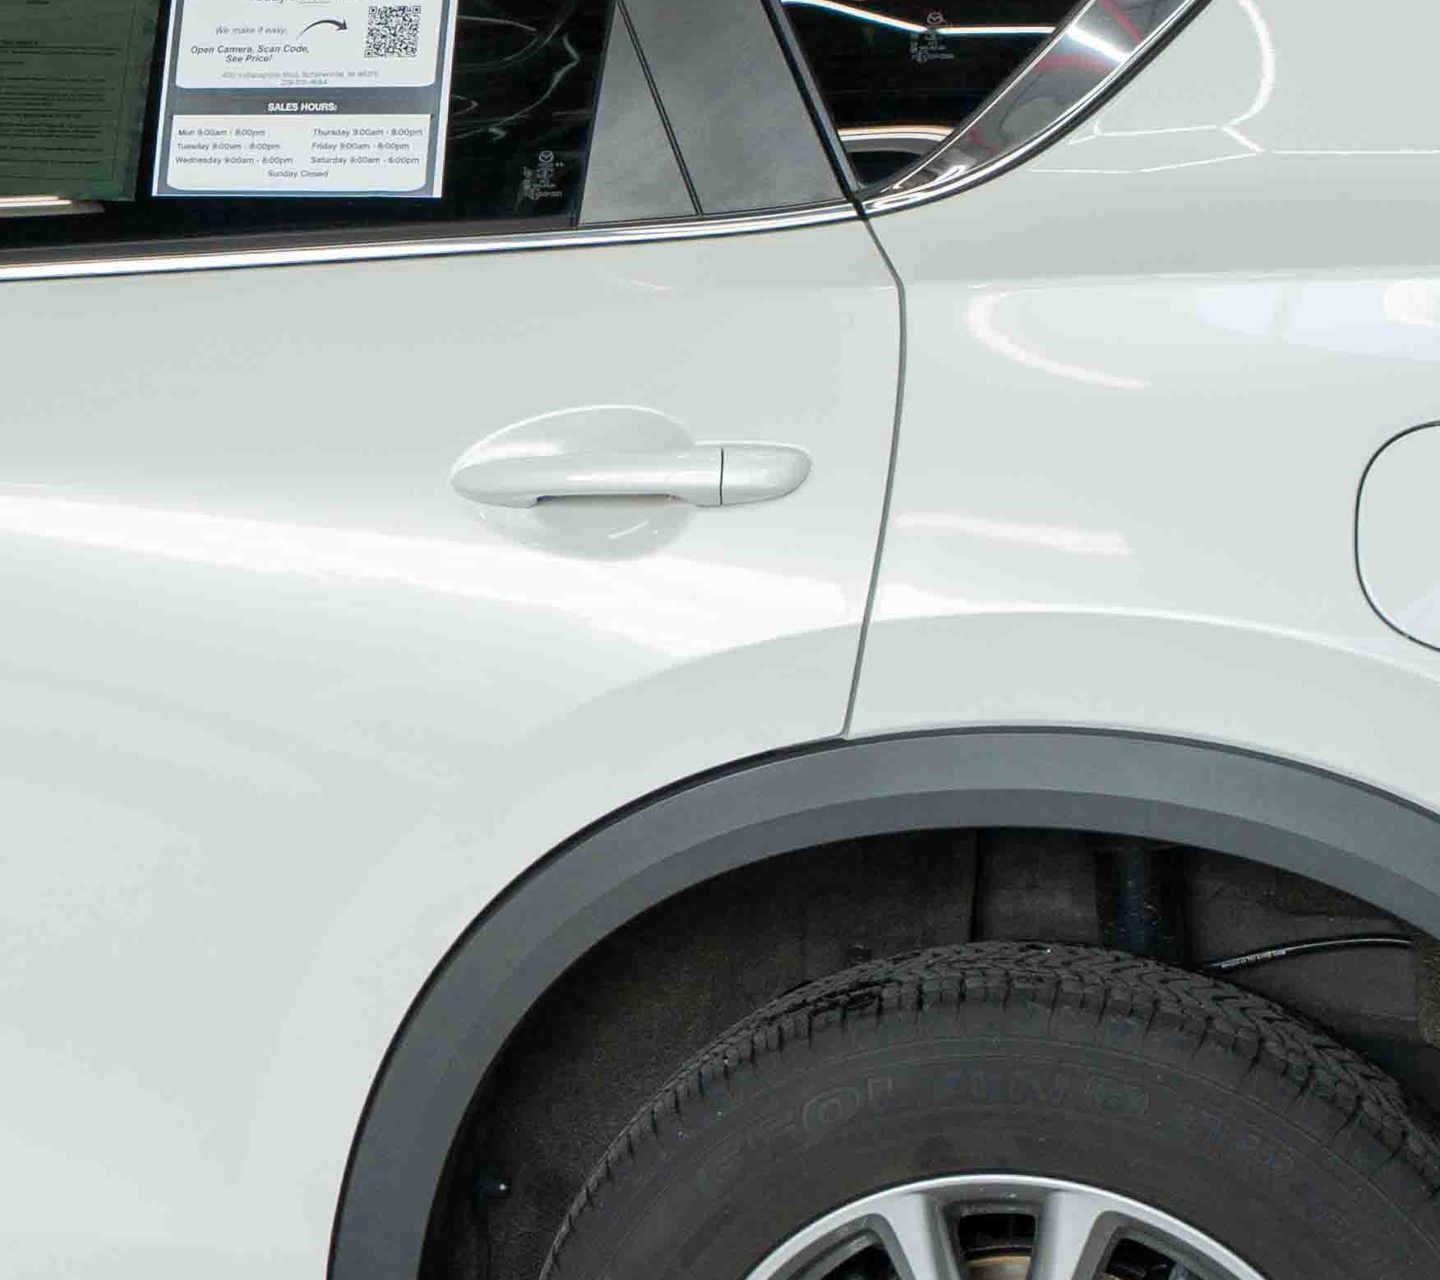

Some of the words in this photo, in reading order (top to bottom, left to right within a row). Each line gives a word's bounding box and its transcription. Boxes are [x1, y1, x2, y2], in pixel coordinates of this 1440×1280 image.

[190, 46, 214, 55] Open
[256, 44, 281, 54] Scan
[225, 54, 243, 63] See
[245, 53, 273, 63] Price!
[268, 102, 298, 111] SALES
[301, 102, 338, 111] HOURS:
[313, 128, 351, 138] Thursday
[175, 156, 222, 166] Wednesday
[268, 170, 298, 179] Sunday
